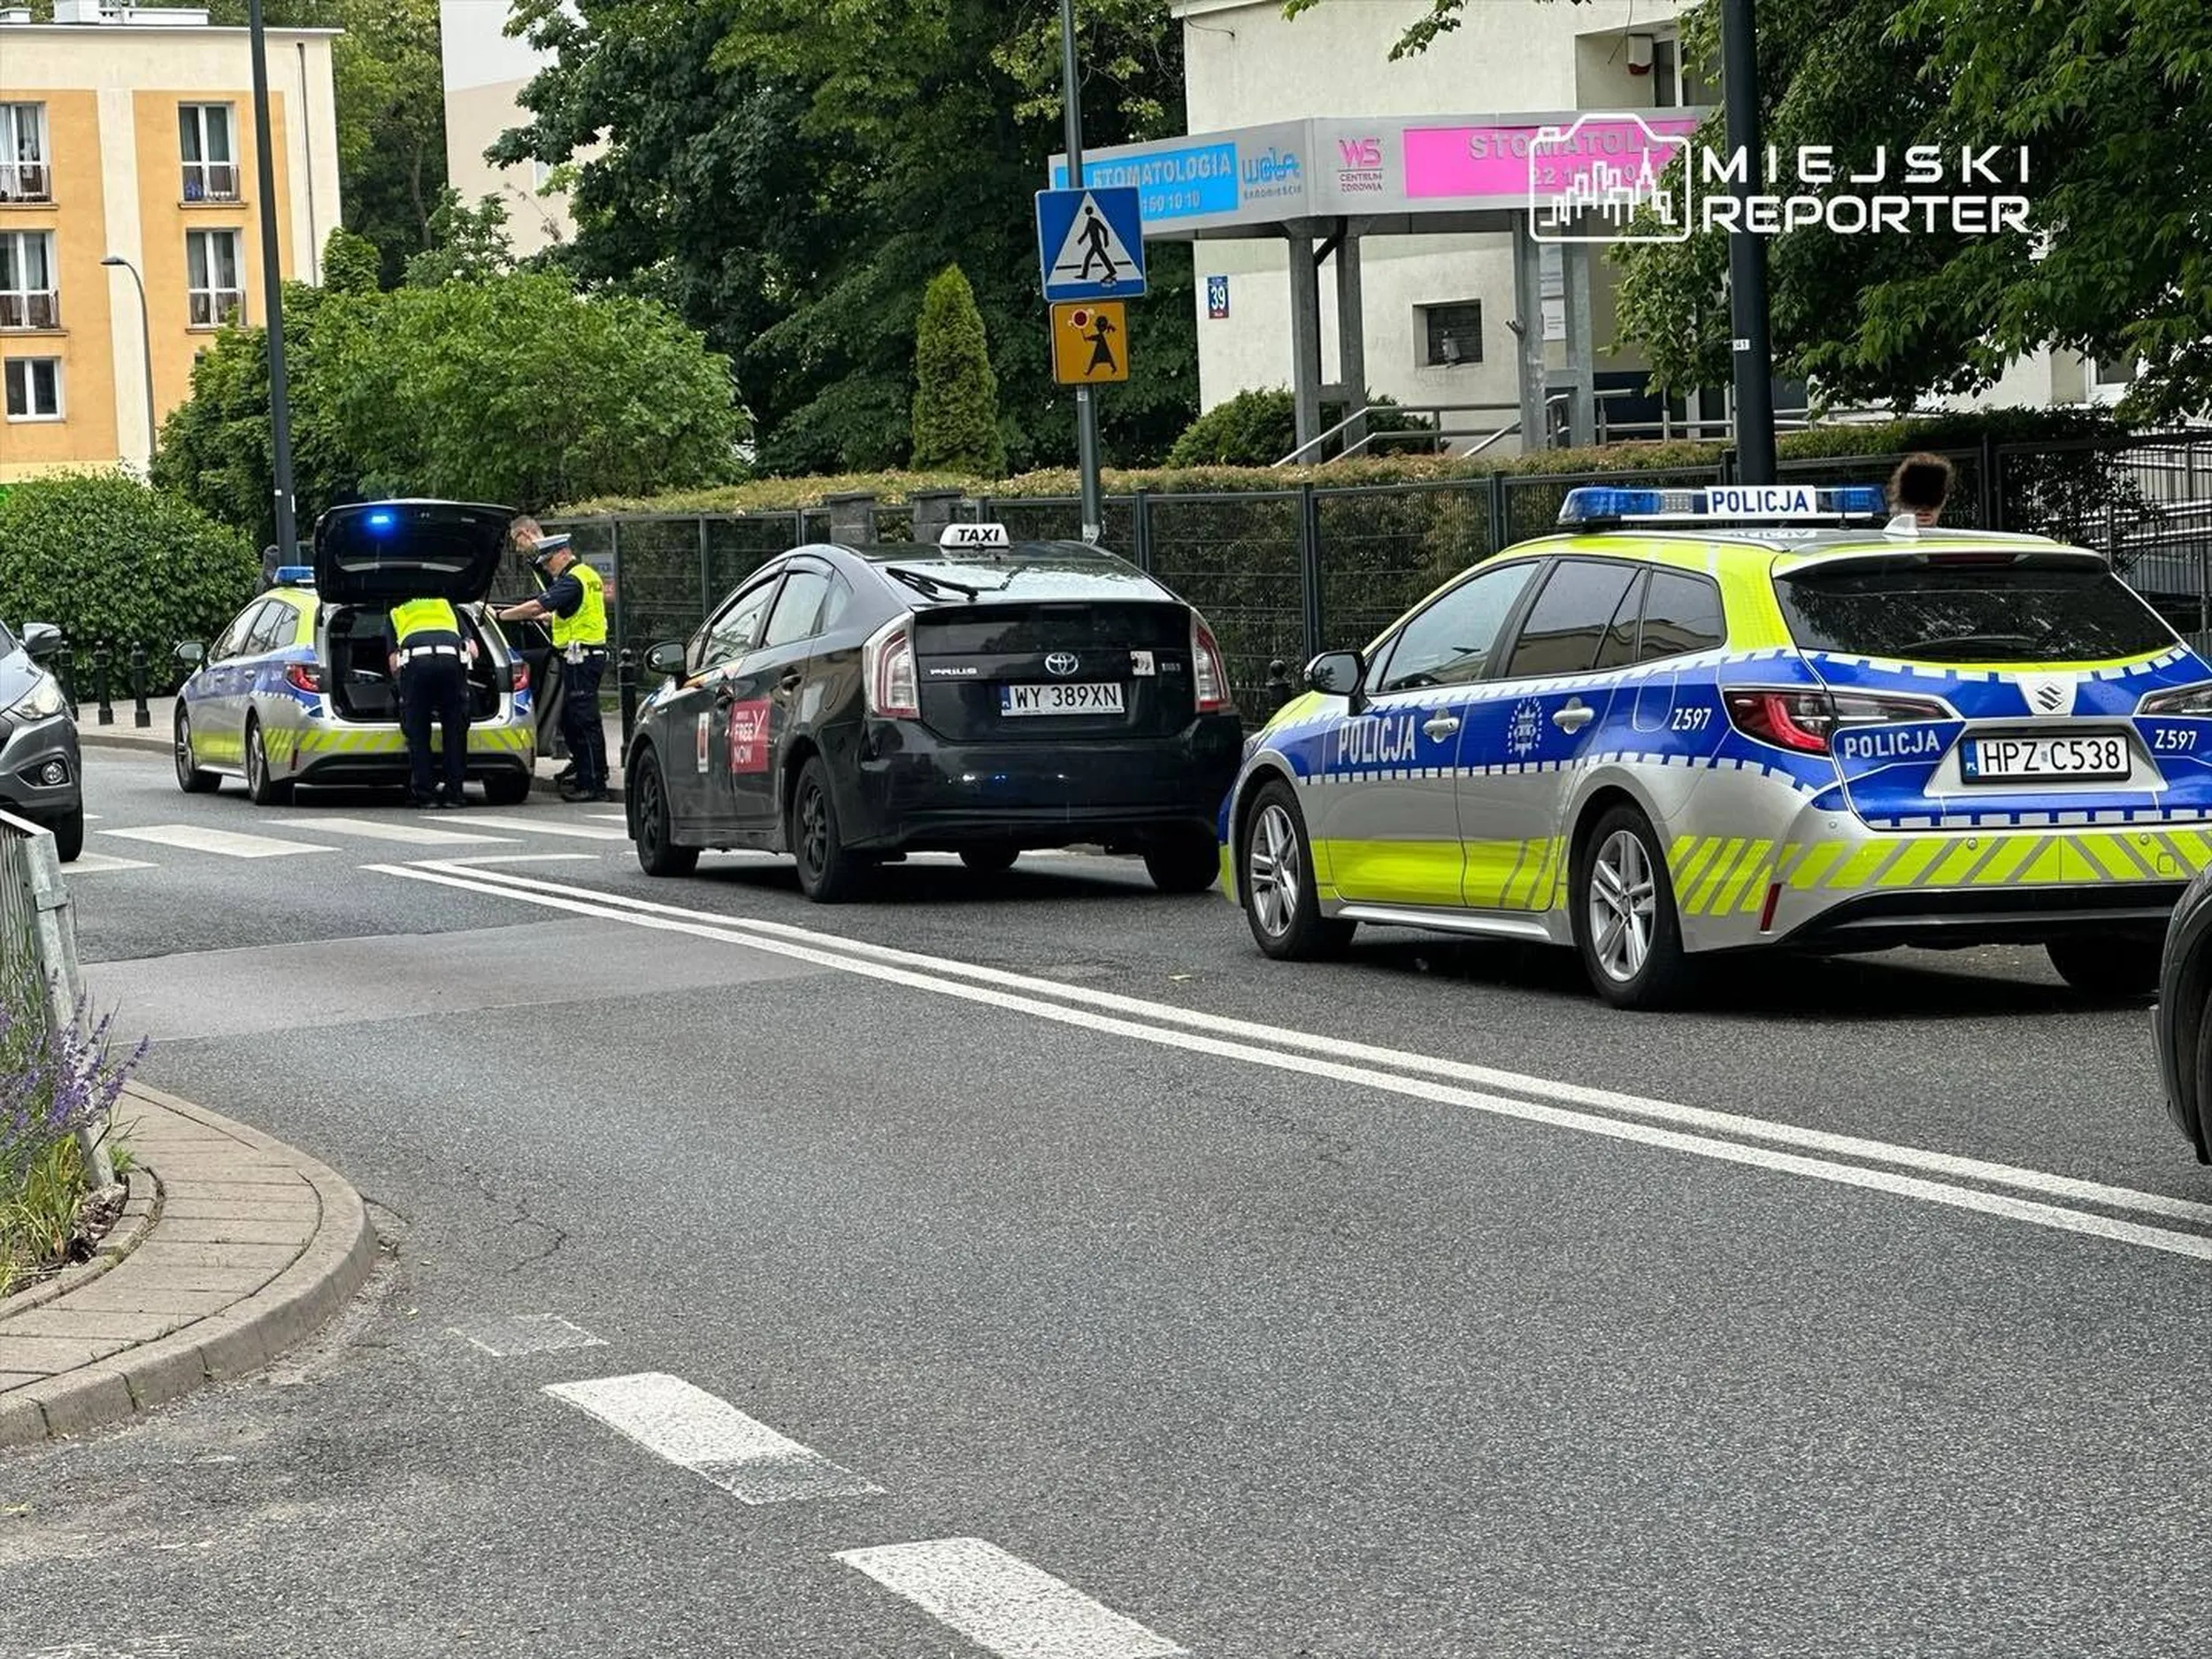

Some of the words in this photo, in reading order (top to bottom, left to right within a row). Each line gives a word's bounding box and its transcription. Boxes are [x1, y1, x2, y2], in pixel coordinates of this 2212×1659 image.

[1338, 138, 1381, 168] WS
[1092, 151, 1233, 188] STOMATOLOGIA
[1340, 172, 1382, 182] CENTRUM
[1340, 182, 1383, 193] ZDROWIA
[1210, 285, 1226, 310] 39
[1711, 490, 1809, 512] POLICJA
[957, 528, 1000, 542] TAXI
[1015, 687, 1041, 708] WY
[1050, 685, 1118, 707] 389XN
[1671, 708, 1712, 730] Z597
[733, 723, 754, 741] FREE
[1337, 715, 1417, 765] POLICJA
[2154, 729, 2197, 750] Z597
[733, 744, 753, 764] NOW
[1844, 729, 1941, 759] POLICJA
[1983, 741, 2040, 772] HPZ
[2049, 741, 2121, 771] C538
